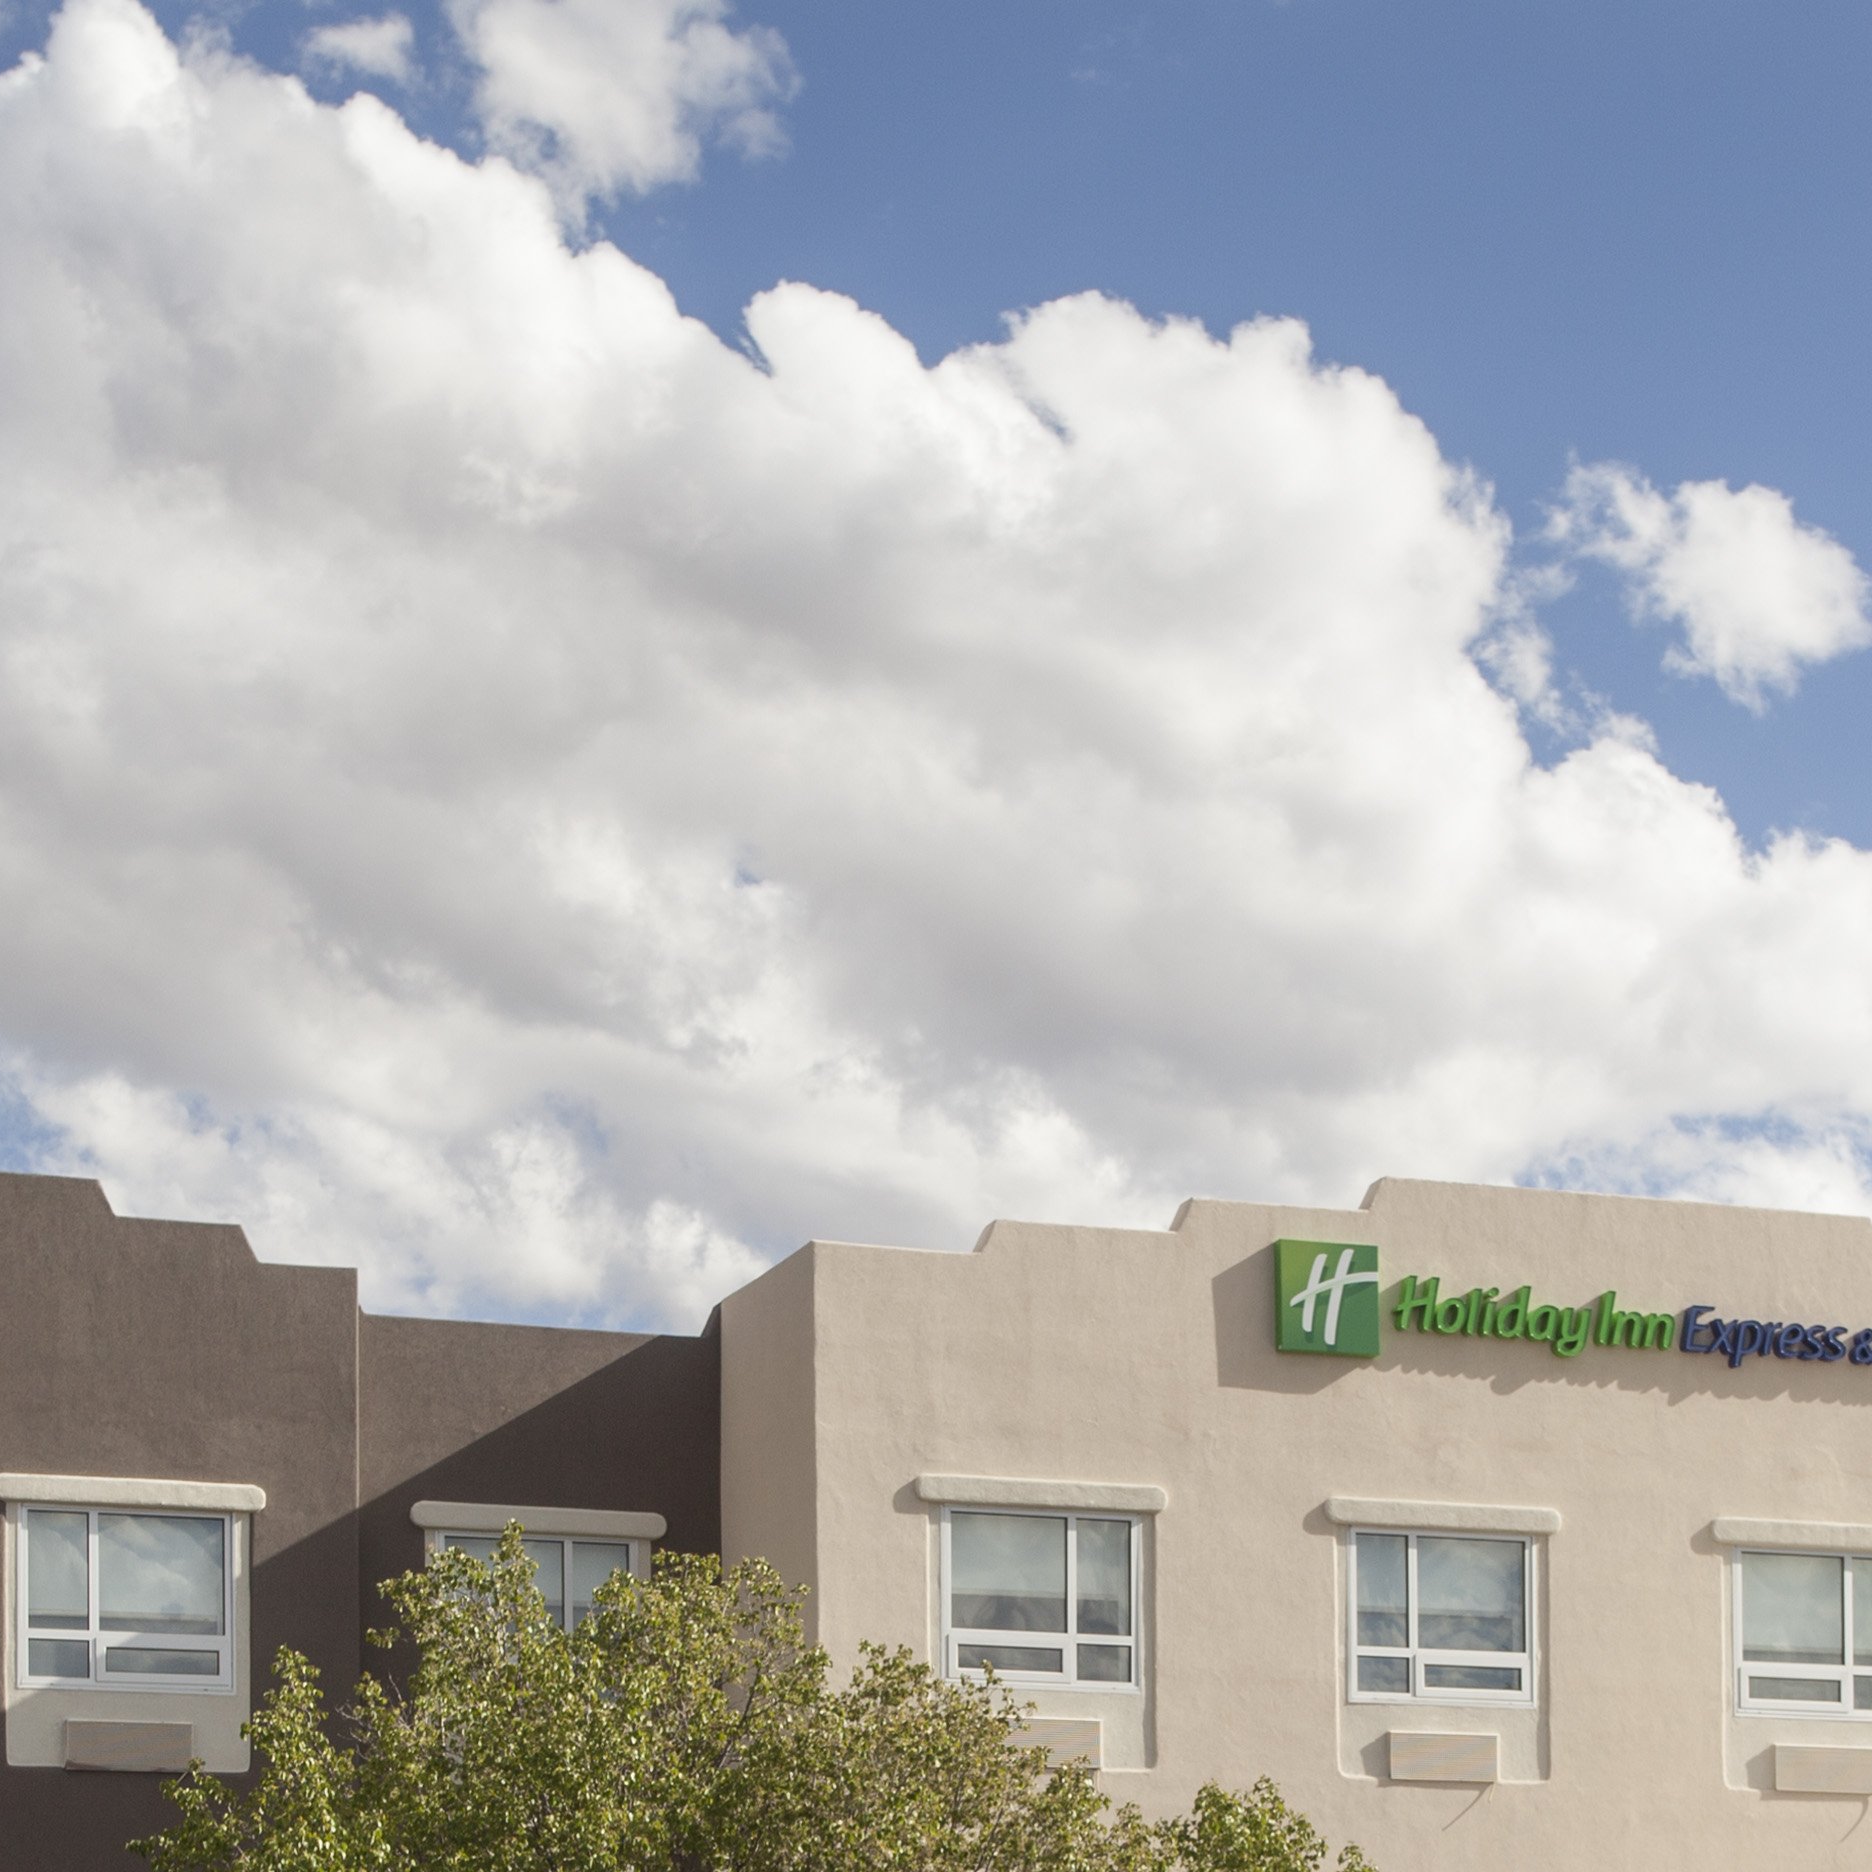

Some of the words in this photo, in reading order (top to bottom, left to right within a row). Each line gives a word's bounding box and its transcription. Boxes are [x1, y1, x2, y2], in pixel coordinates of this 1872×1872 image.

[1393, 1275, 1592, 1357] Holiday
[1594, 1290, 1675, 1350] Inn
[1680, 1305, 1848, 1368] Express
